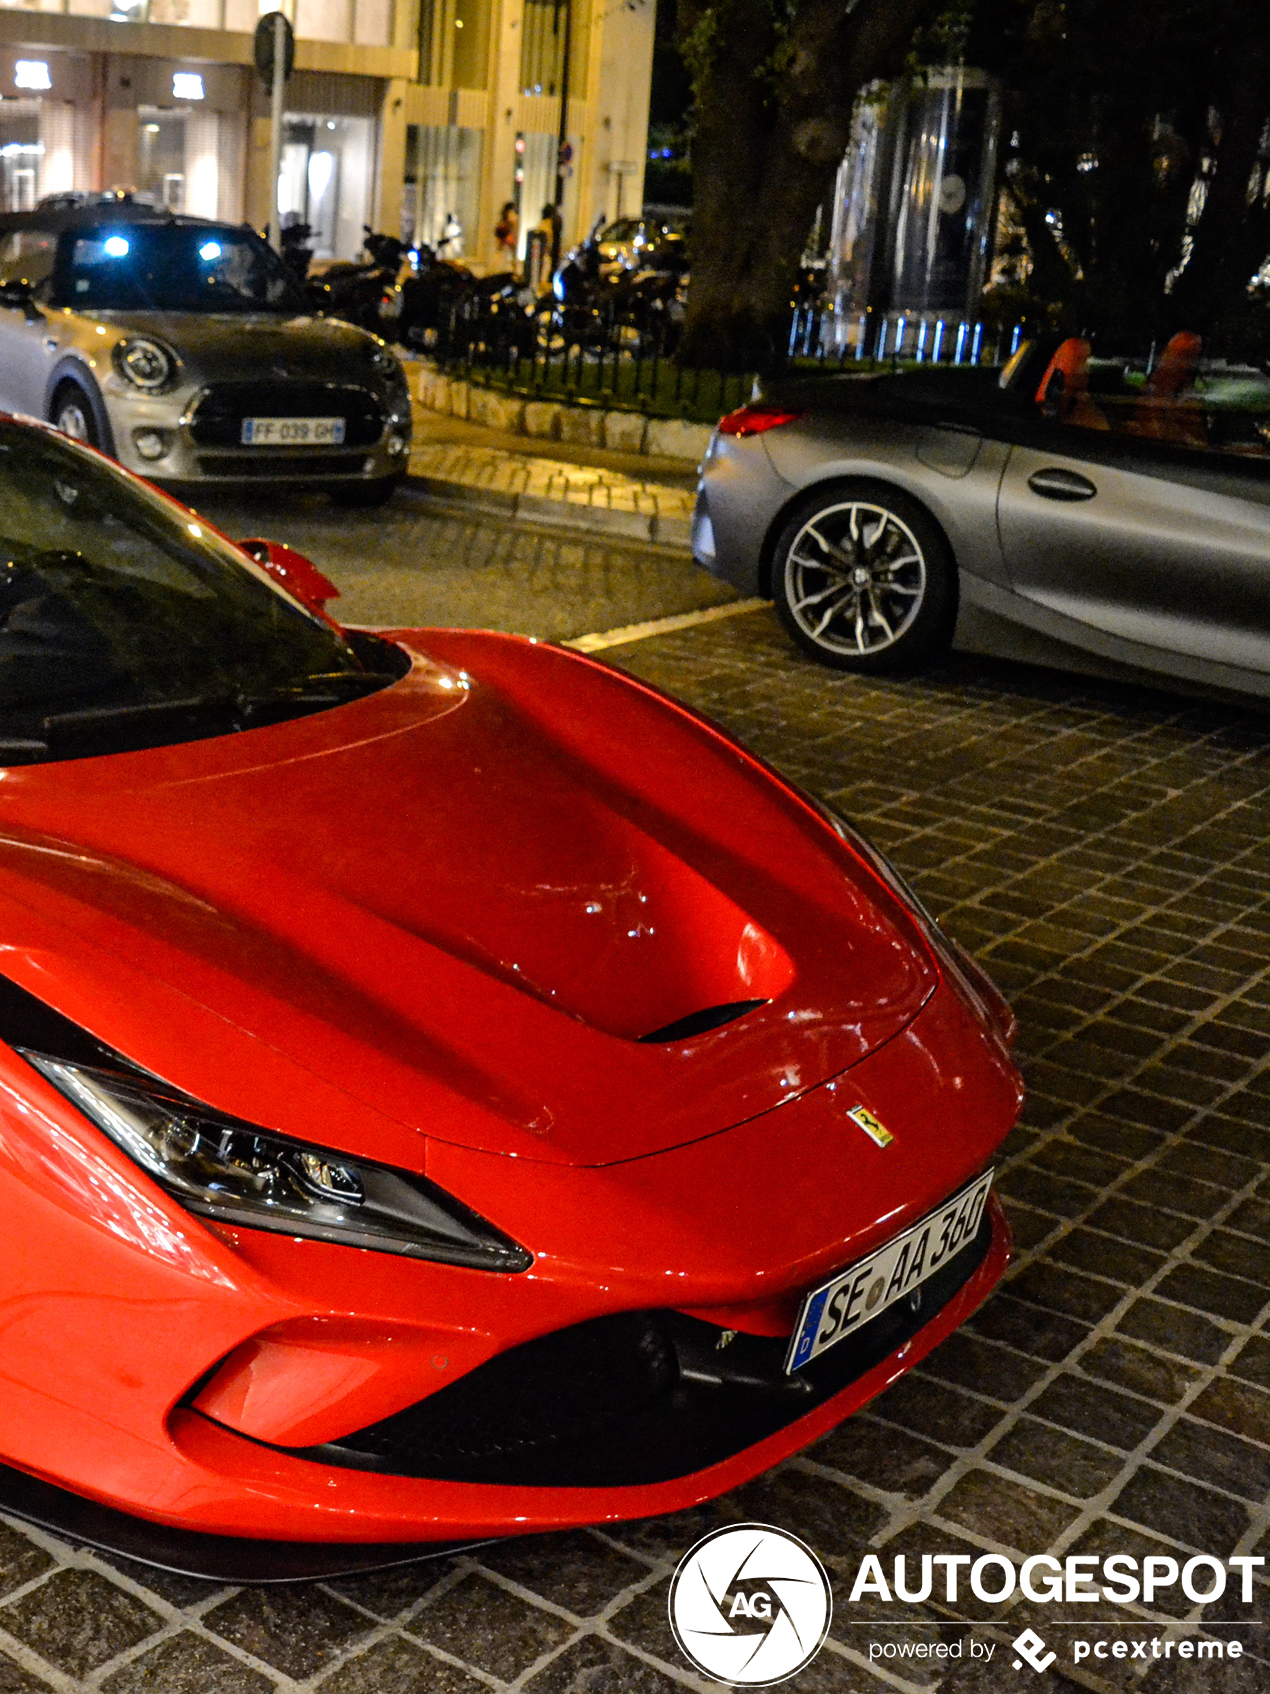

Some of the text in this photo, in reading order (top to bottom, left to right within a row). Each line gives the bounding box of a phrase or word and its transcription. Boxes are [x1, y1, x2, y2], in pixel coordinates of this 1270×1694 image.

[819, 1266, 873, 1344] SE
[884, 1227, 931, 1302] AA
[930, 1183, 987, 1267] 360
